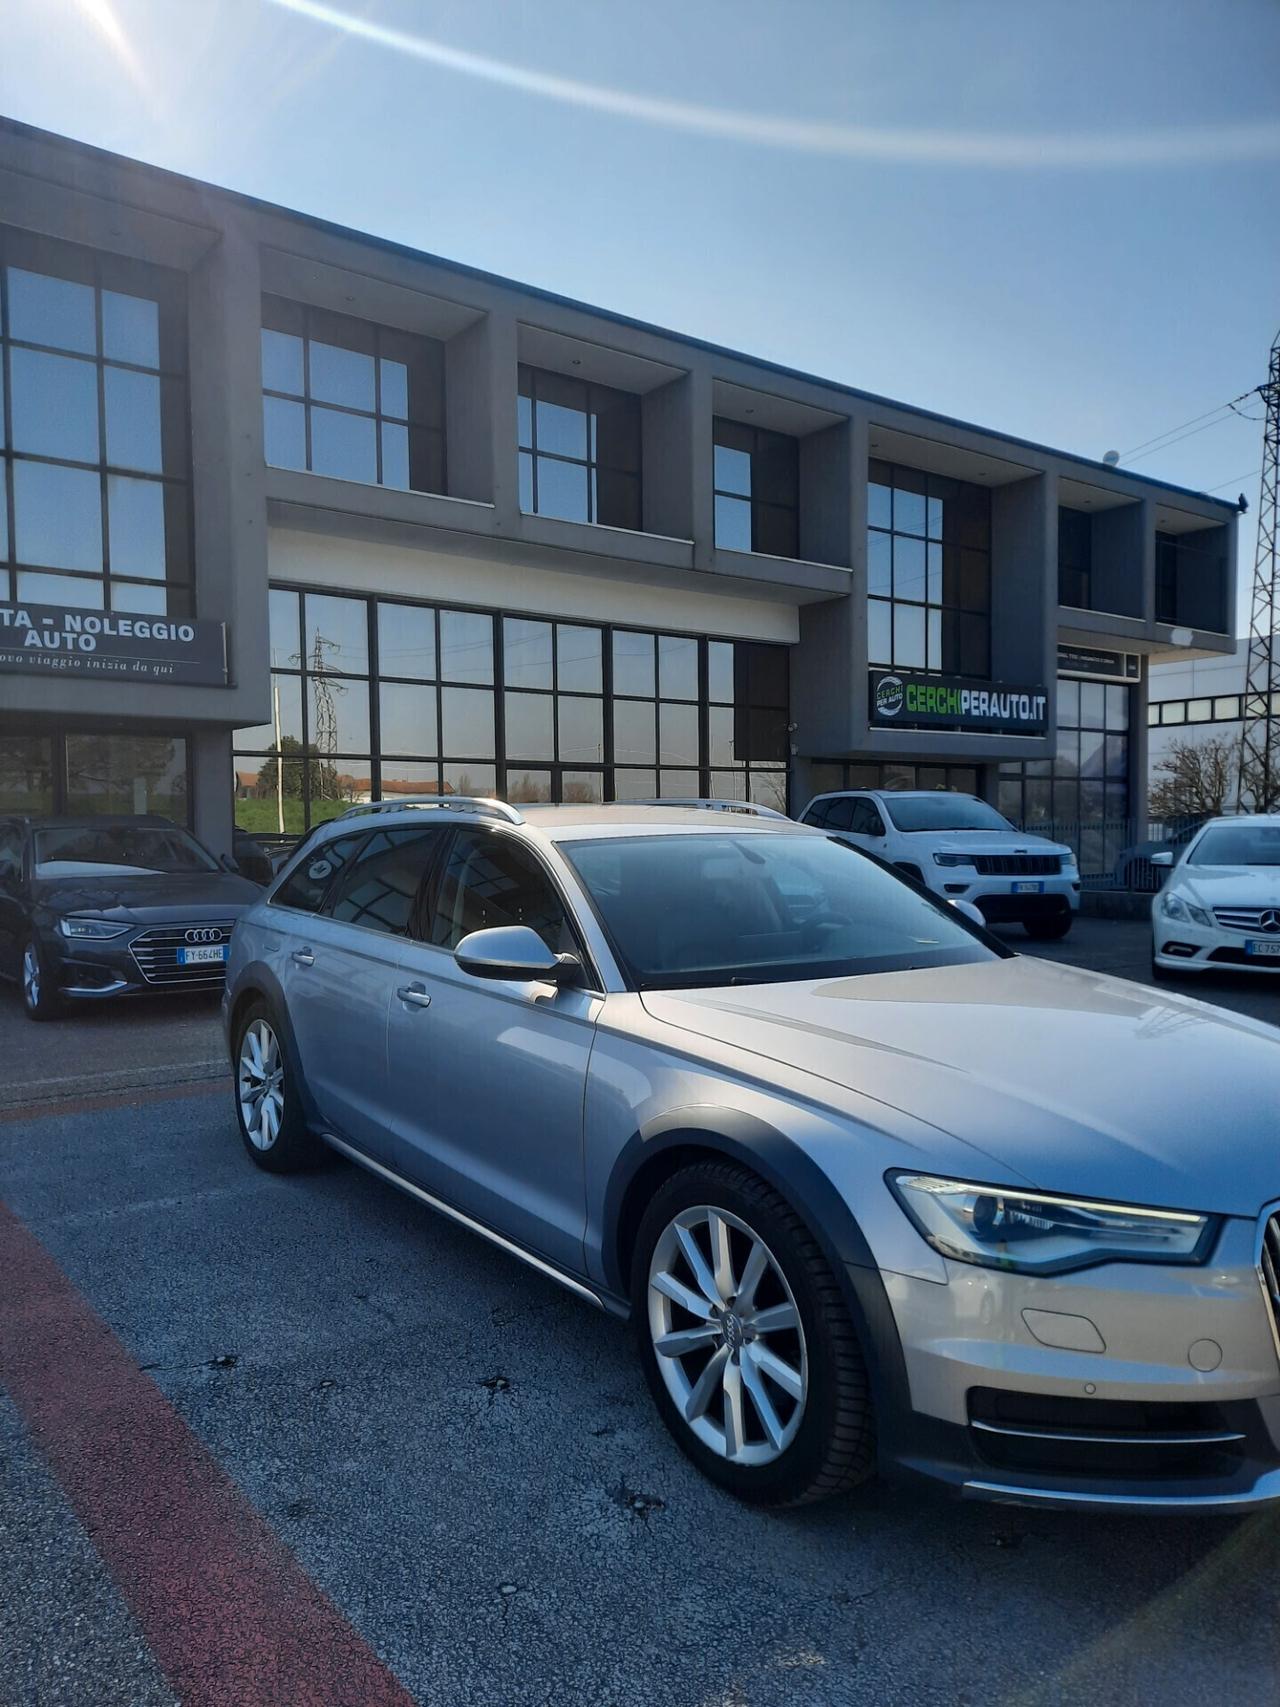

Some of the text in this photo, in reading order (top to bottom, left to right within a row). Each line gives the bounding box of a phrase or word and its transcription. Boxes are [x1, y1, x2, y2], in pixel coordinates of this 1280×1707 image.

[64, 614, 195, 642] NOLEGGIO
[24, 629, 97, 652] AUTO
[29, 654, 81, 669] viaggio
[87, 657, 127, 671] inizia
[132, 661, 148, 671] da
[153, 663, 175, 675] qui
[876, 685, 904, 699] CERCHI
[876, 692, 904, 708] PER AUTO
[906, 684, 1046, 720] CERCHIPERAUTO.IT
